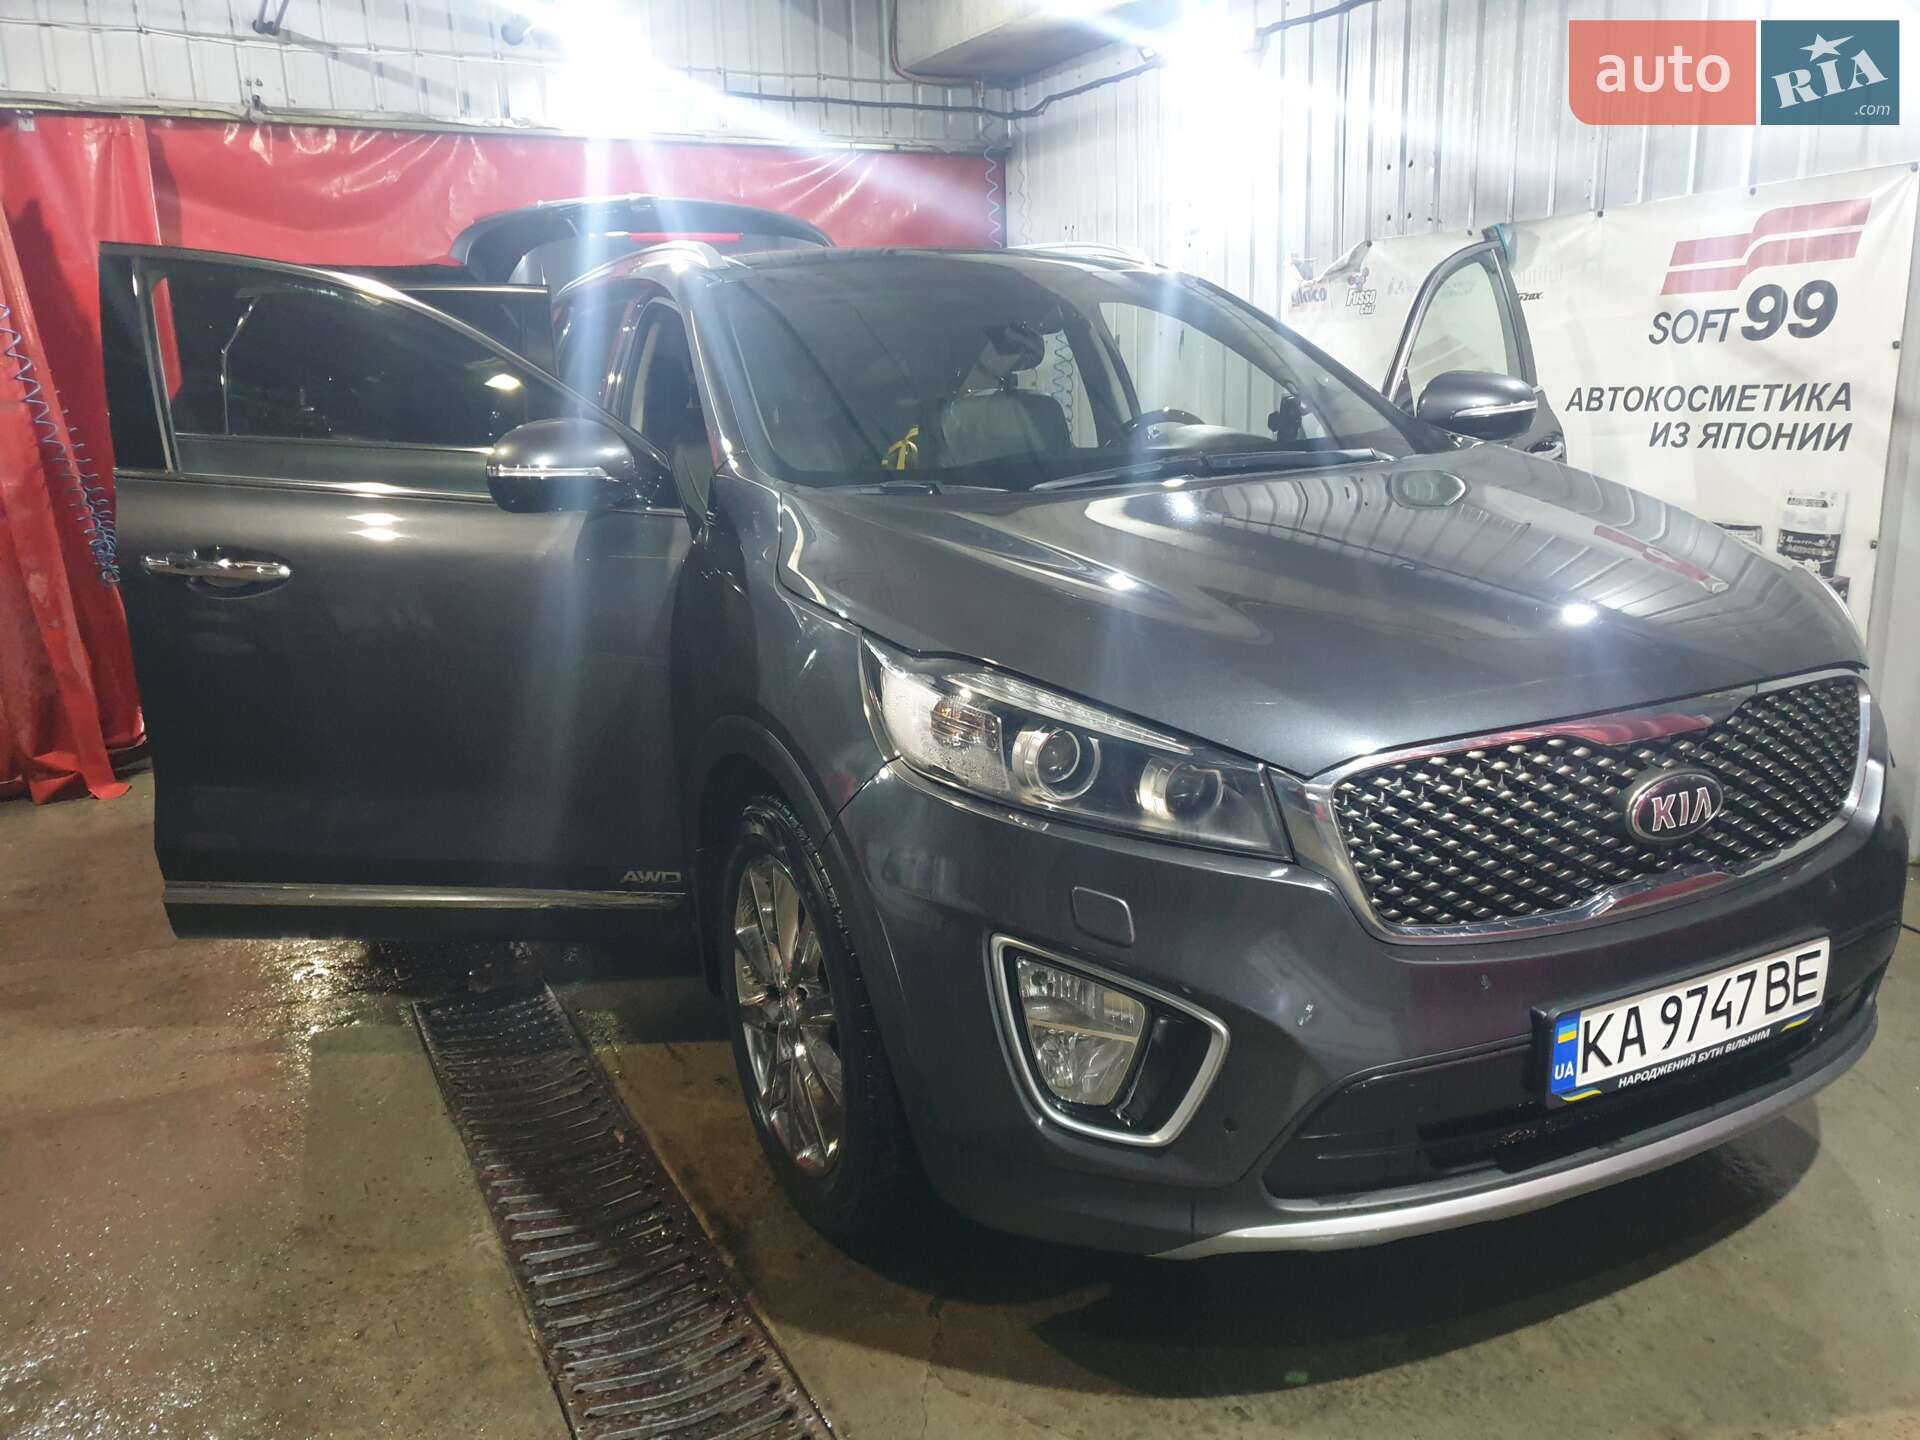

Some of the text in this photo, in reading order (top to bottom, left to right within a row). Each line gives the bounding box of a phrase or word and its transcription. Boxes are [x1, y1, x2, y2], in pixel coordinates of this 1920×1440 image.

[1565, 382, 1852, 413] АВТОКОСМЕТИКА
[1648, 421, 1853, 452] ИЗ ЯПОНИИ
[1651, 786, 1712, 832] KIA
[621, 870, 682, 883] AWD
[1581, 949, 1822, 1074] KA 9747 BE
[1554, 1063, 1575, 1081] UA
[1618, 1028, 1771, 1089] НАРОДЖЕНИЙ БУТИ ВІЛЬНИМ
